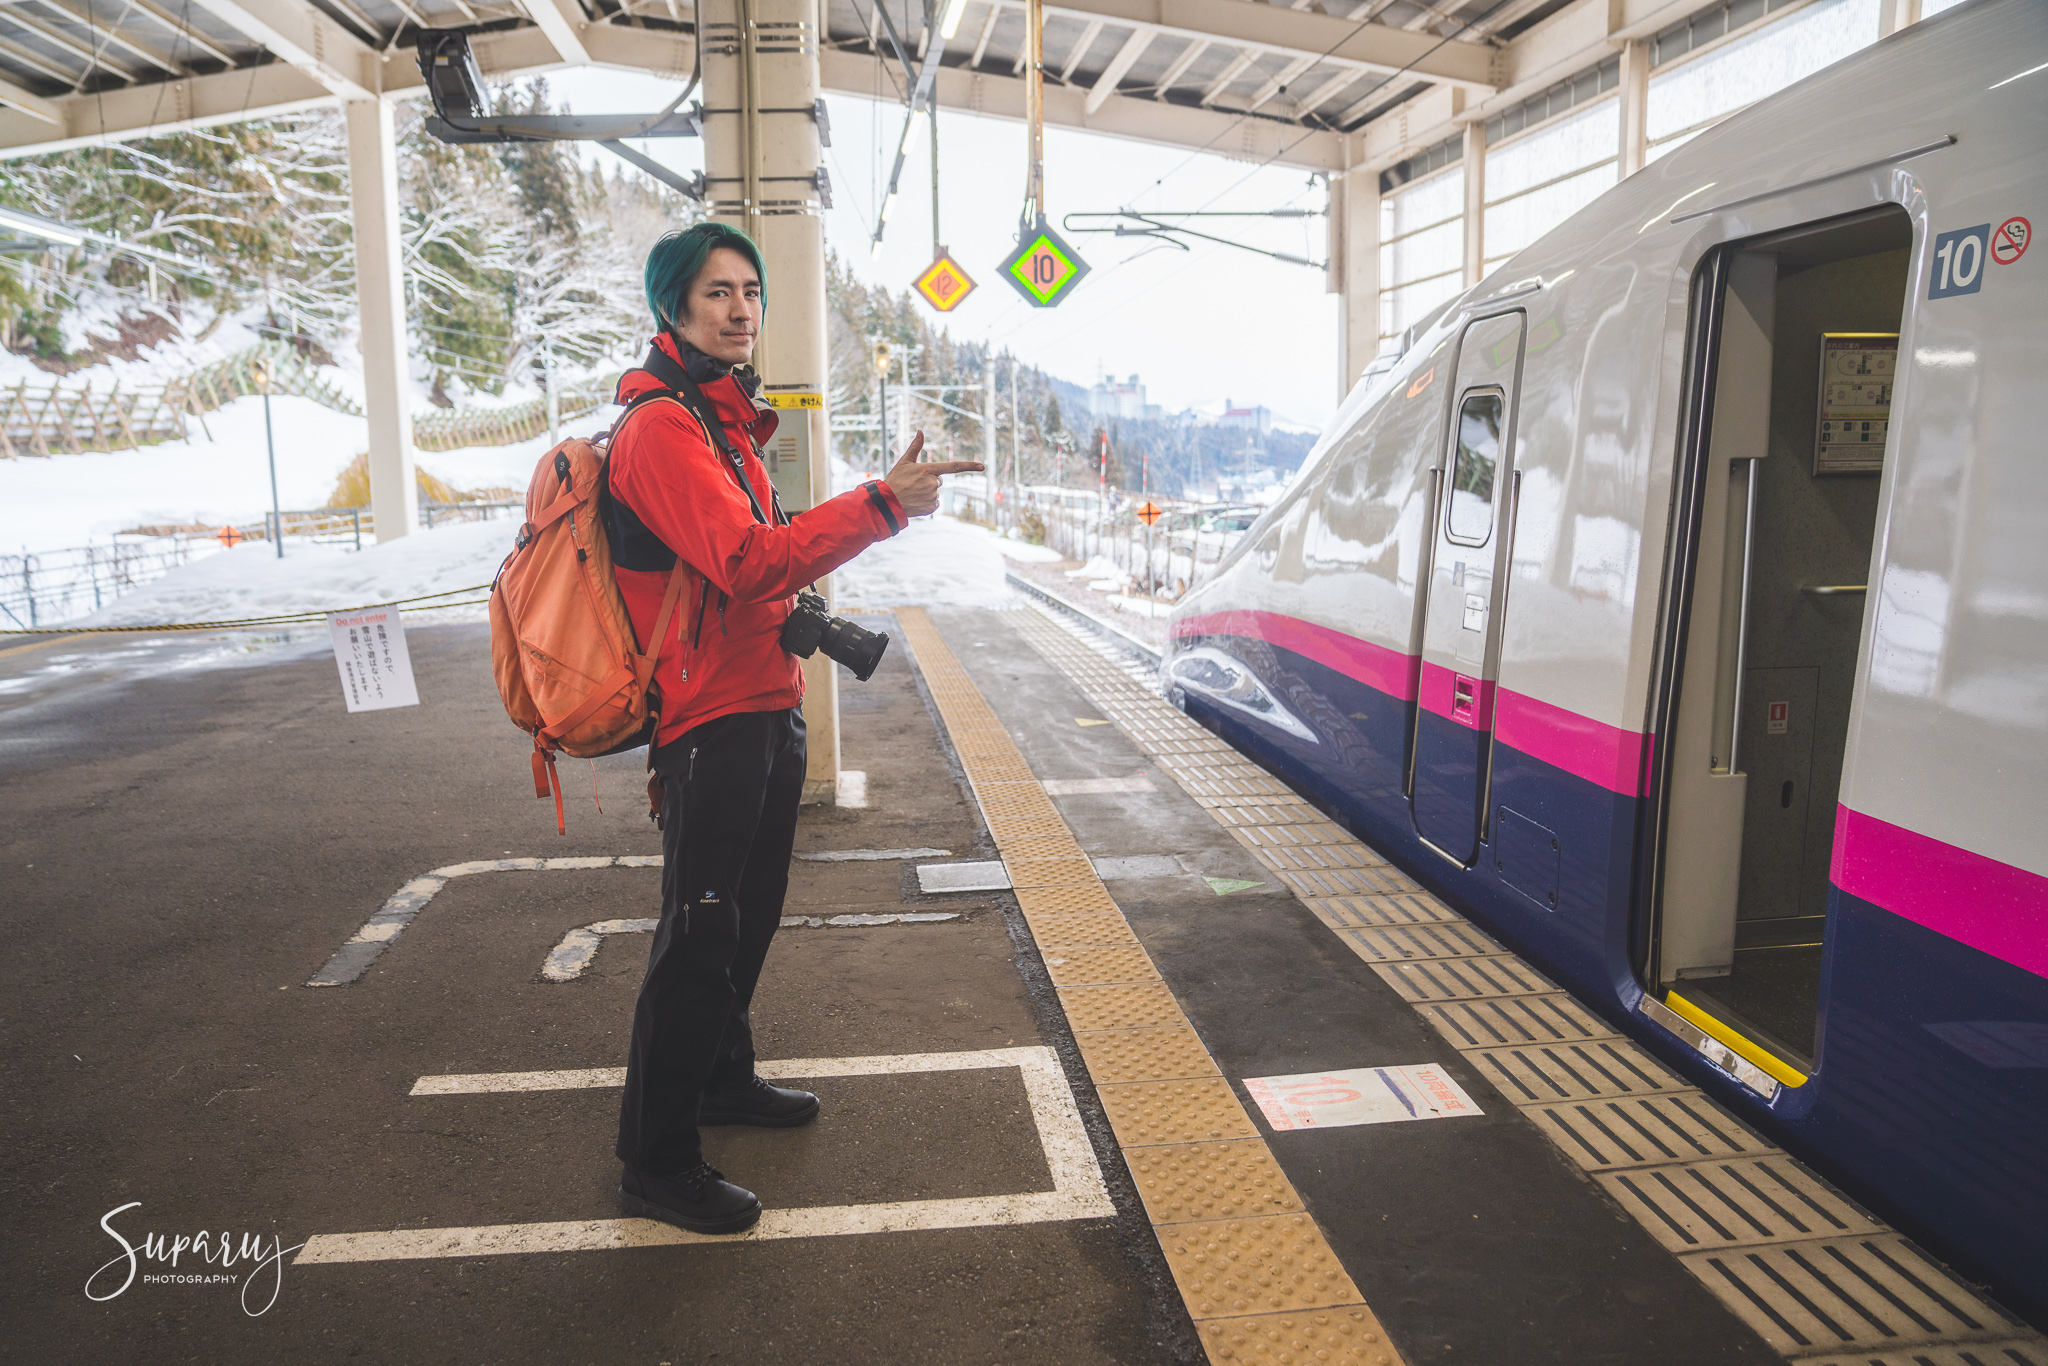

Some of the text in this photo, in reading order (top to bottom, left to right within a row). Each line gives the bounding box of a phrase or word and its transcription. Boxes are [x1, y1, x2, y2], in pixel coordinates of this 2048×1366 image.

[1033, 254, 1055, 284] 10
[1937, 234, 1983, 290] 10
[937, 275, 952, 296] 12
[335, 613, 387, 626] Do not enter
